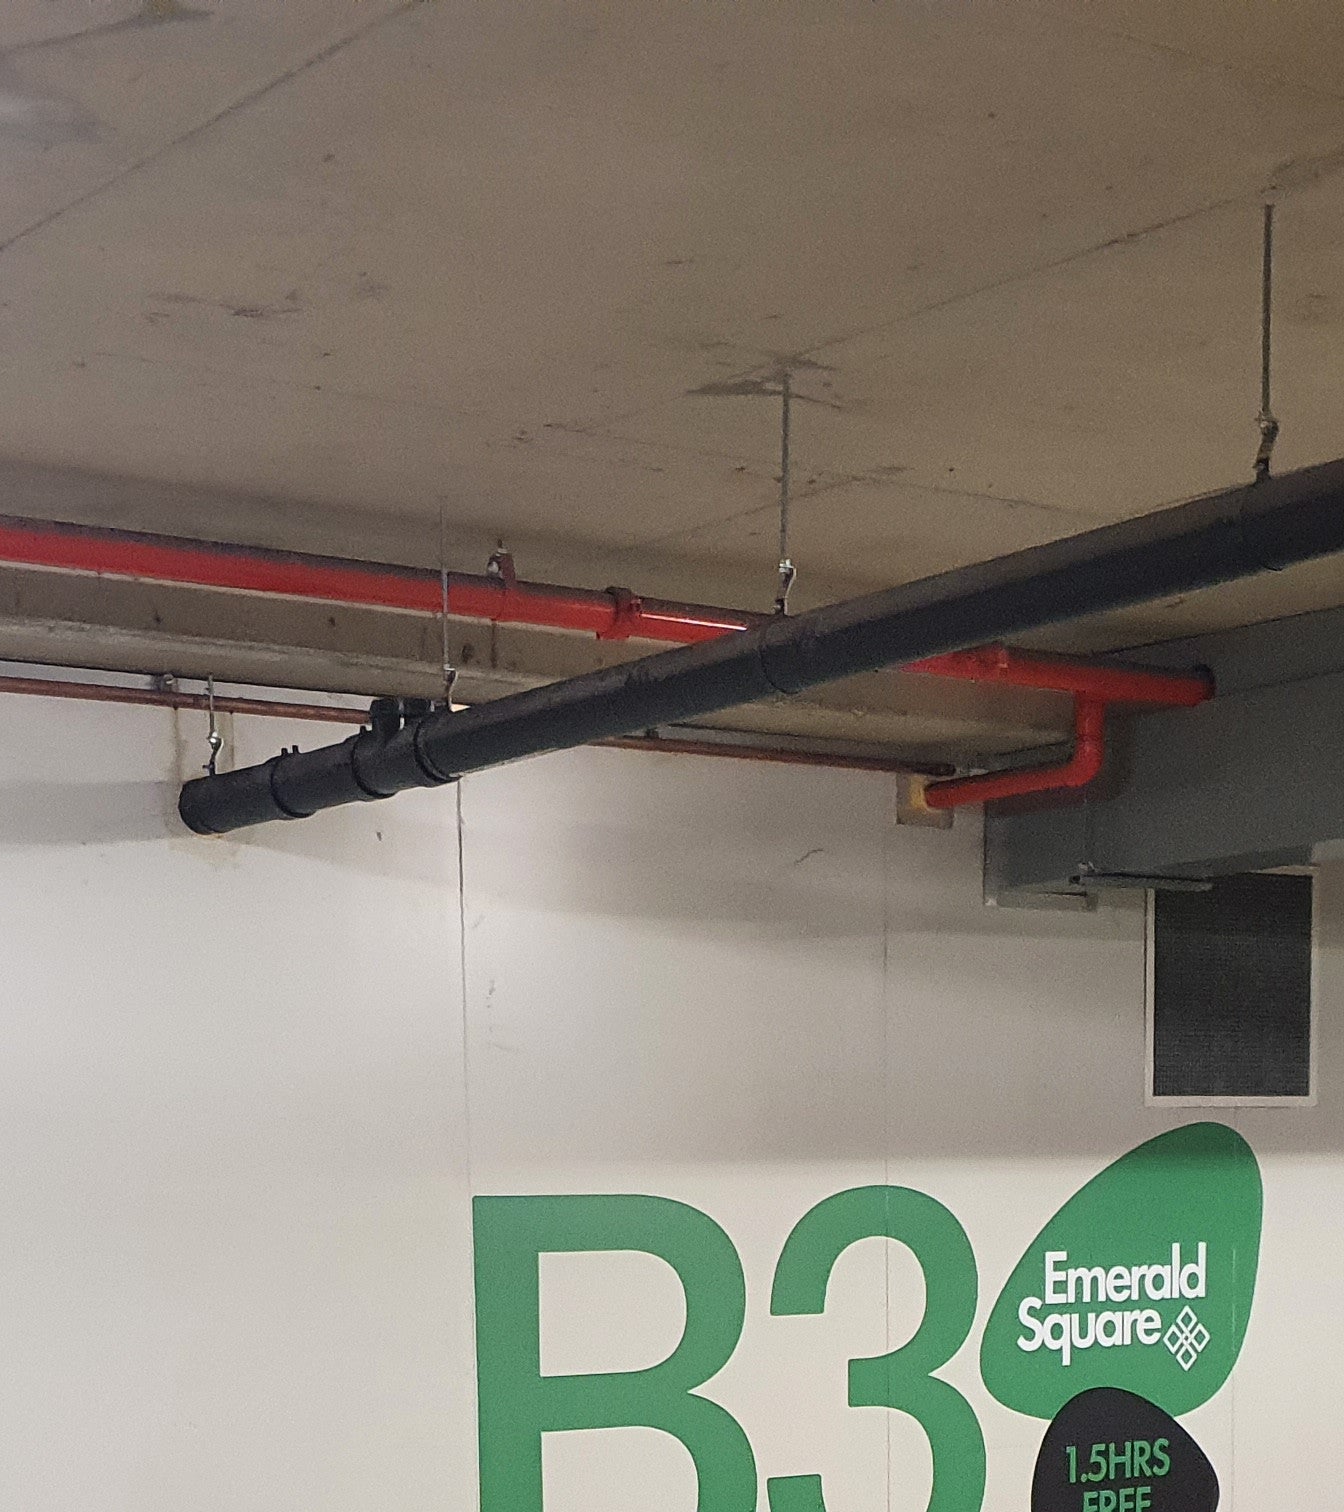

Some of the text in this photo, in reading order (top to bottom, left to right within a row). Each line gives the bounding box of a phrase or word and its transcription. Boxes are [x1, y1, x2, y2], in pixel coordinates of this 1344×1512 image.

[1044, 1241, 1207, 1305] Emerald
[1016, 1296, 1162, 1367] Square
[1065, 1438, 1170, 1484] 1.5HRS
